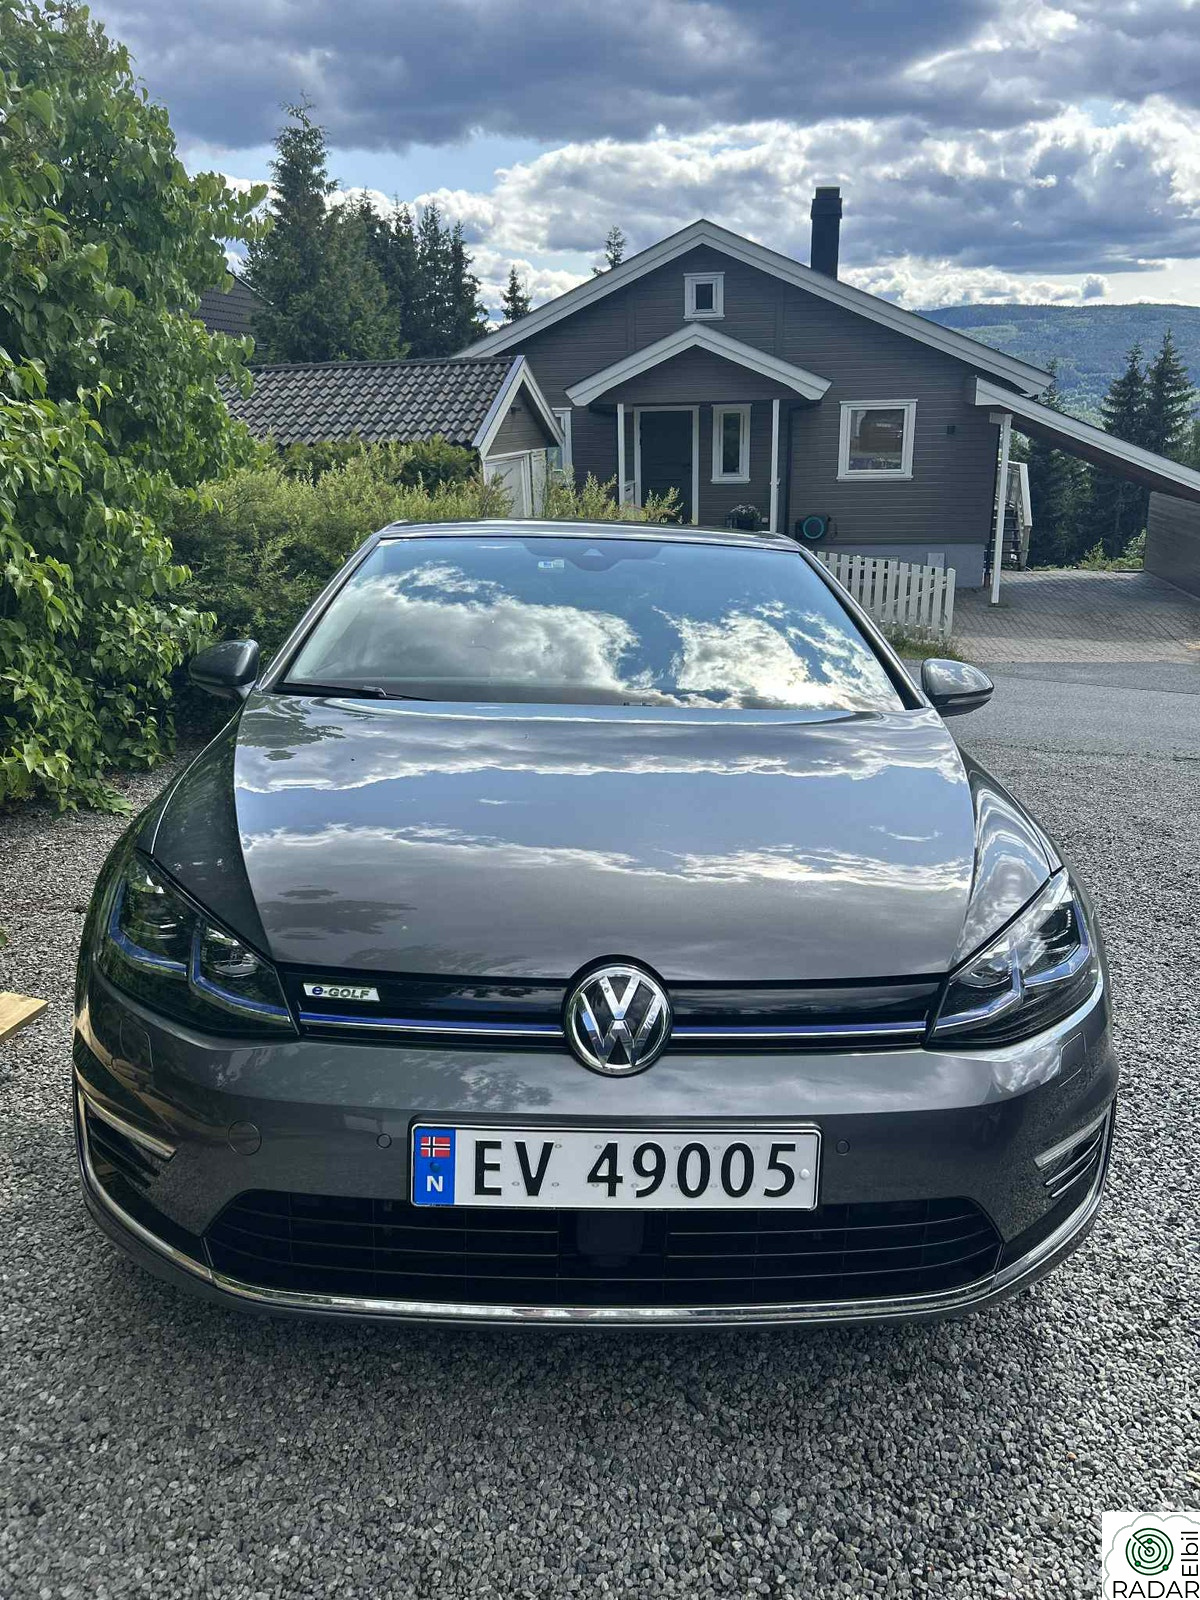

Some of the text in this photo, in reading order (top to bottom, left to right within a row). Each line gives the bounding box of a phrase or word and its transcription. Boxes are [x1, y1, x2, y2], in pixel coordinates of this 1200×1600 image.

[426, 1175, 443, 1192] N
[474, 1140, 797, 1198] EV 49005
